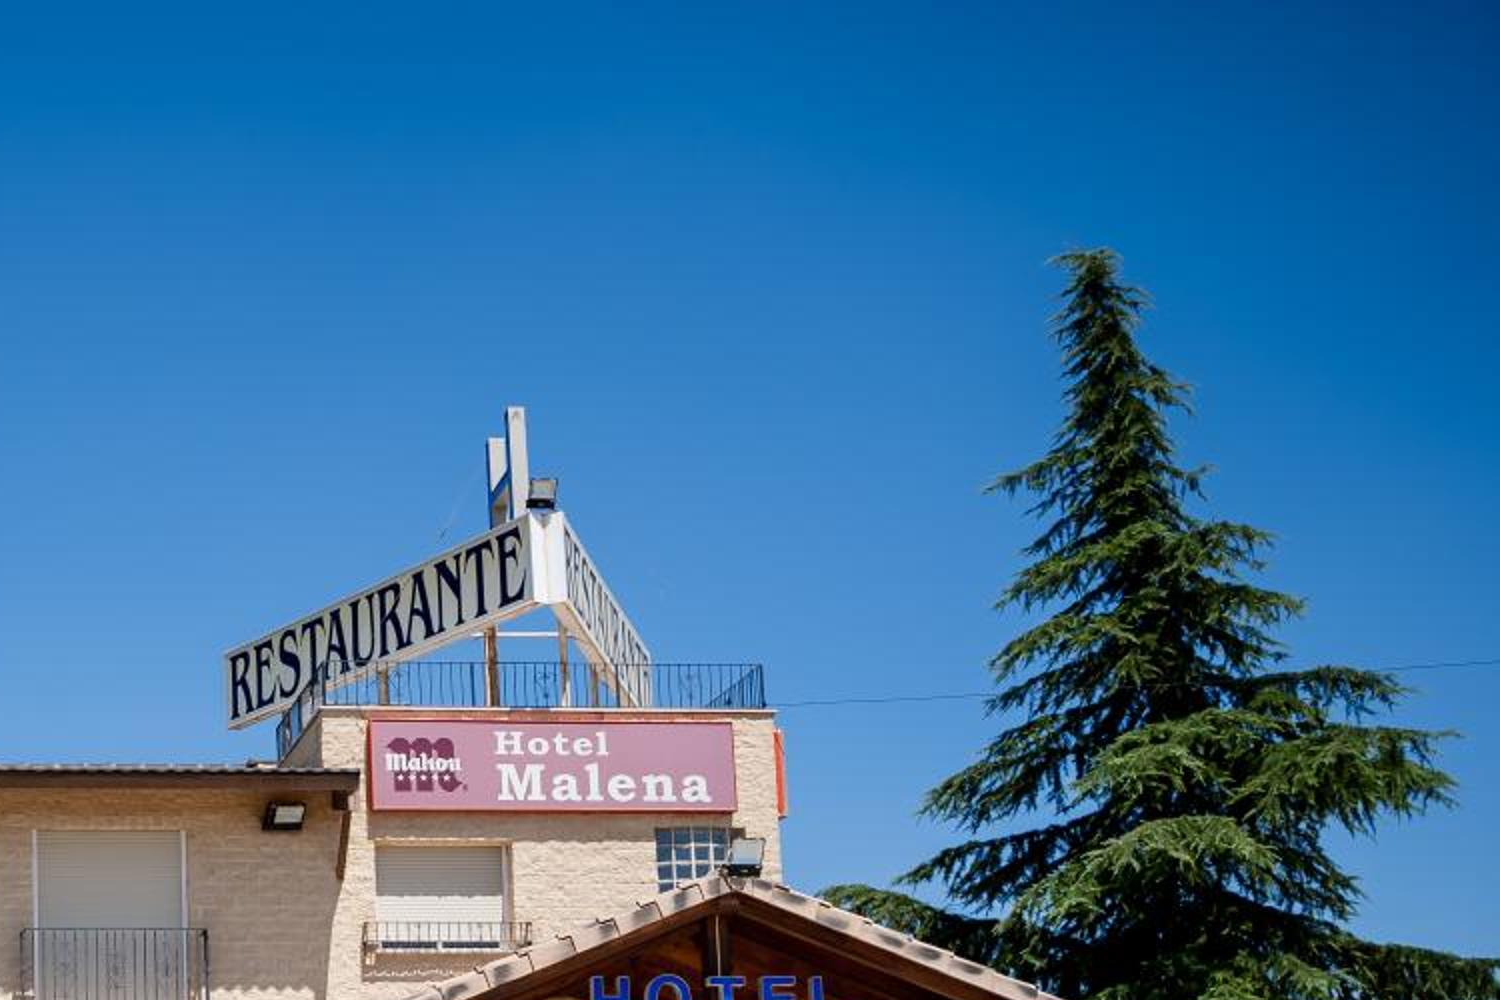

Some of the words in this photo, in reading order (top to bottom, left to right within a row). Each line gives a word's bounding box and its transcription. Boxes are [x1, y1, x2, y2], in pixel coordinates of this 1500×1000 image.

[229, 525, 527, 720] RESTAURANTE
[493, 731, 609, 756] Hotel
[385, 753, 462, 772] Mahou
[496, 763, 712, 803] Malena
